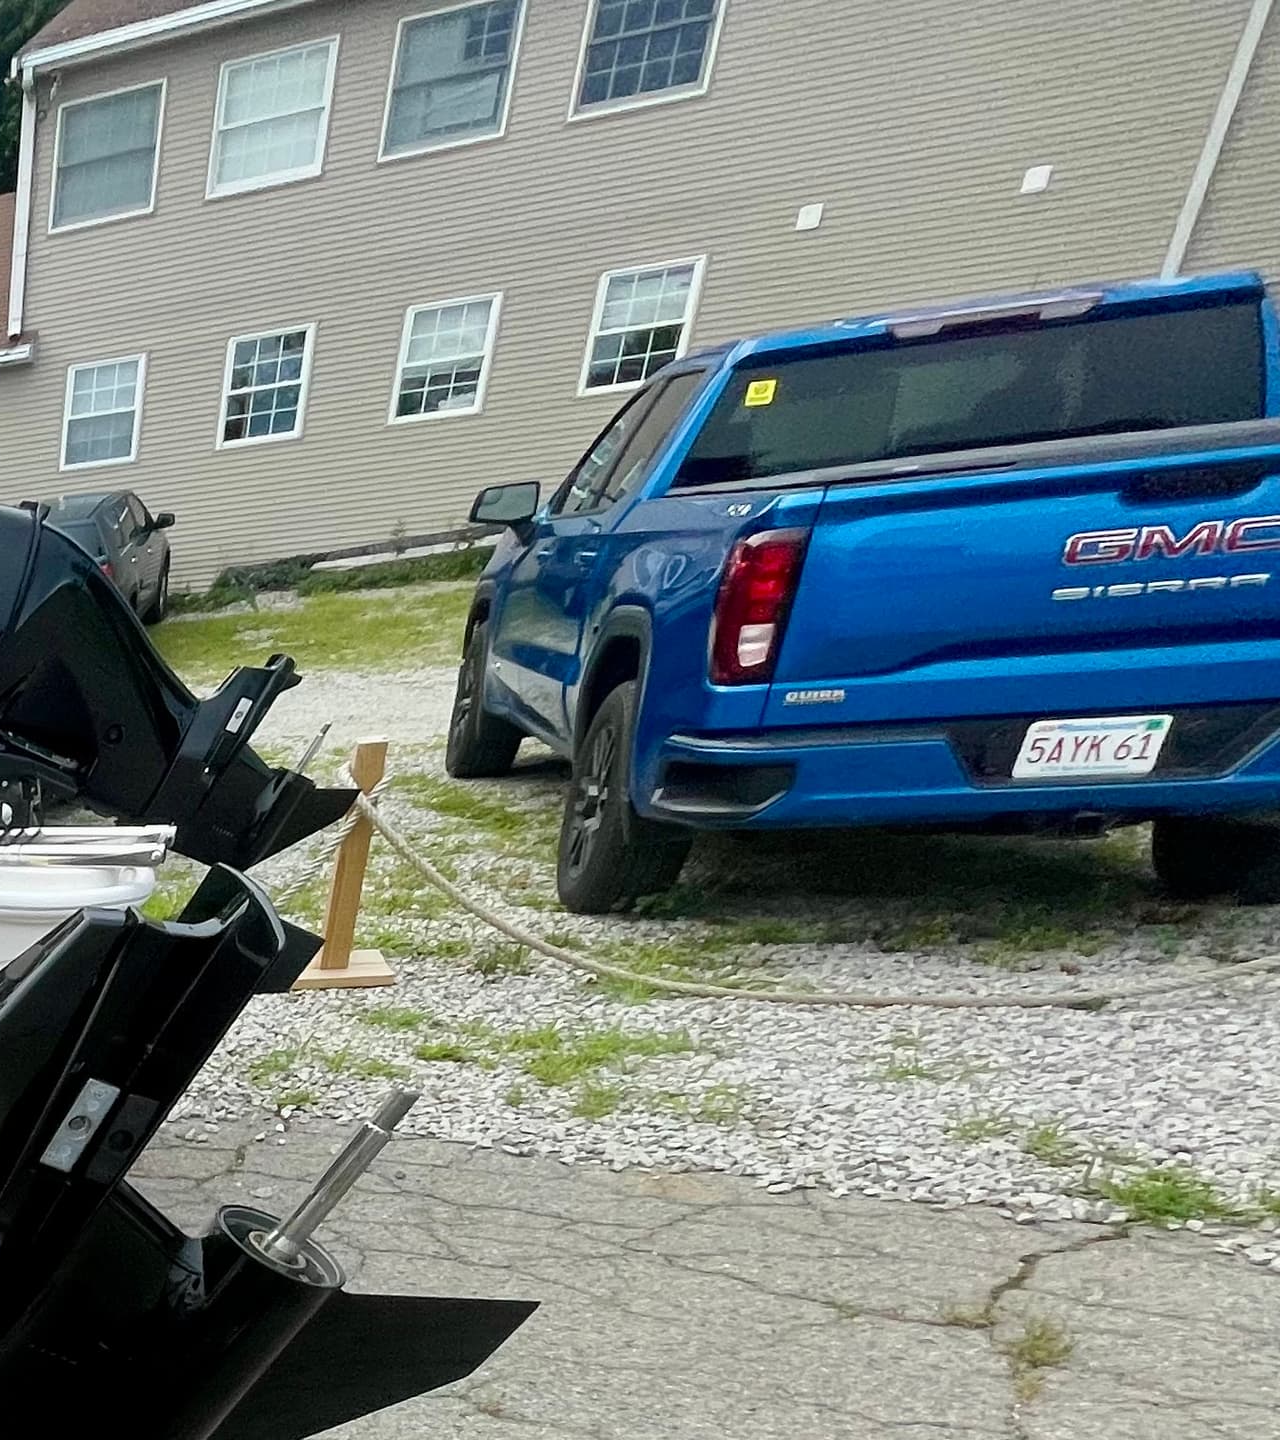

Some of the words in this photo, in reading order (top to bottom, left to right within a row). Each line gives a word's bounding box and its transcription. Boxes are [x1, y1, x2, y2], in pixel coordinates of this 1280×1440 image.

[1062, 515, 1280, 566] GMC
[1051, 573, 1271, 601] SIERRA
[1026, 734, 1112, 763] 5AYK
[1113, 733, 1153, 760] 61
